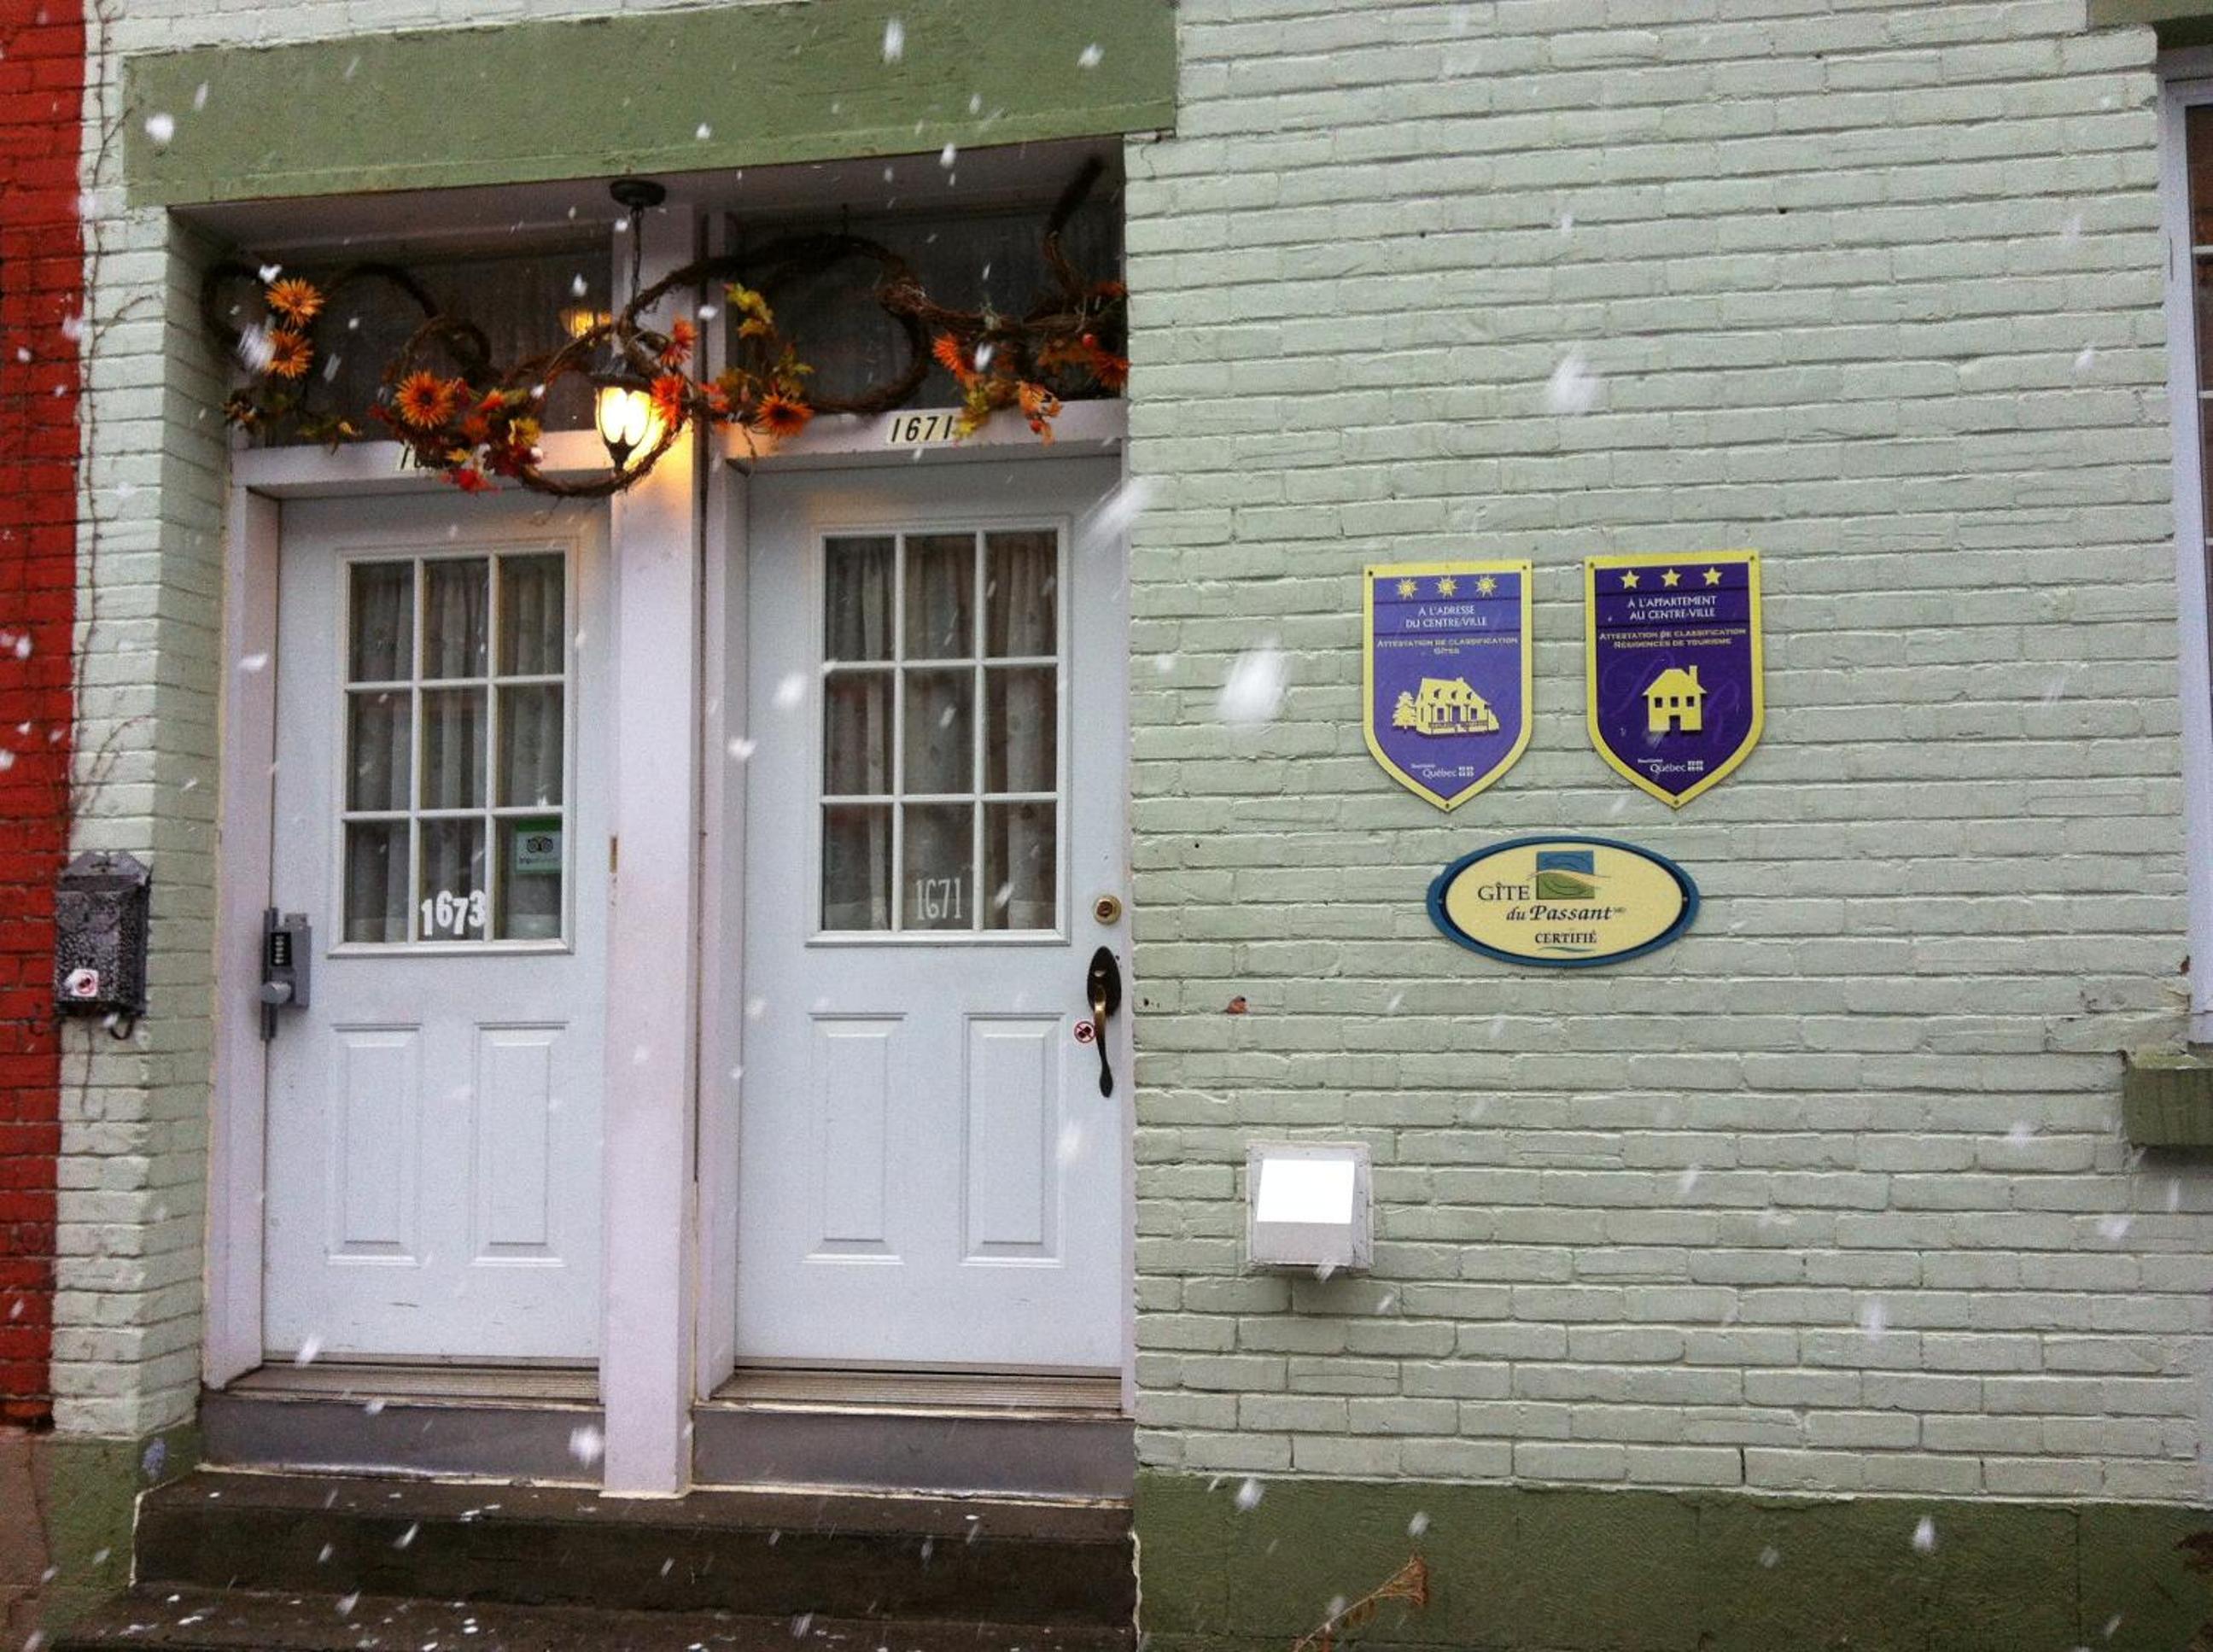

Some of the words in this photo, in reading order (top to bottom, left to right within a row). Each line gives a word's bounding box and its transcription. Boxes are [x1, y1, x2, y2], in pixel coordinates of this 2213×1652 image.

[891, 415, 953, 442] 1671
[1638, 595, 1717, 608] L'APPARTEMENT
[1429, 604, 1475, 616] L'ADRESSE
[1630, 610, 1645, 620] AU
[1648, 607, 1715, 619] CENTRE-VILLE
[1405, 619, 1420, 628] DU
[1422, 768, 1457, 779] Québec
[1650, 763, 1686, 775] Québec
[1478, 881, 1530, 901] GÎTE
[916, 878, 962, 920] 1671
[421, 890, 486, 936] 1673
[1506, 906, 1526, 921] du
[1529, 905, 1613, 921] Passant
[1535, 930, 1597, 944] CERTIFIÉ
